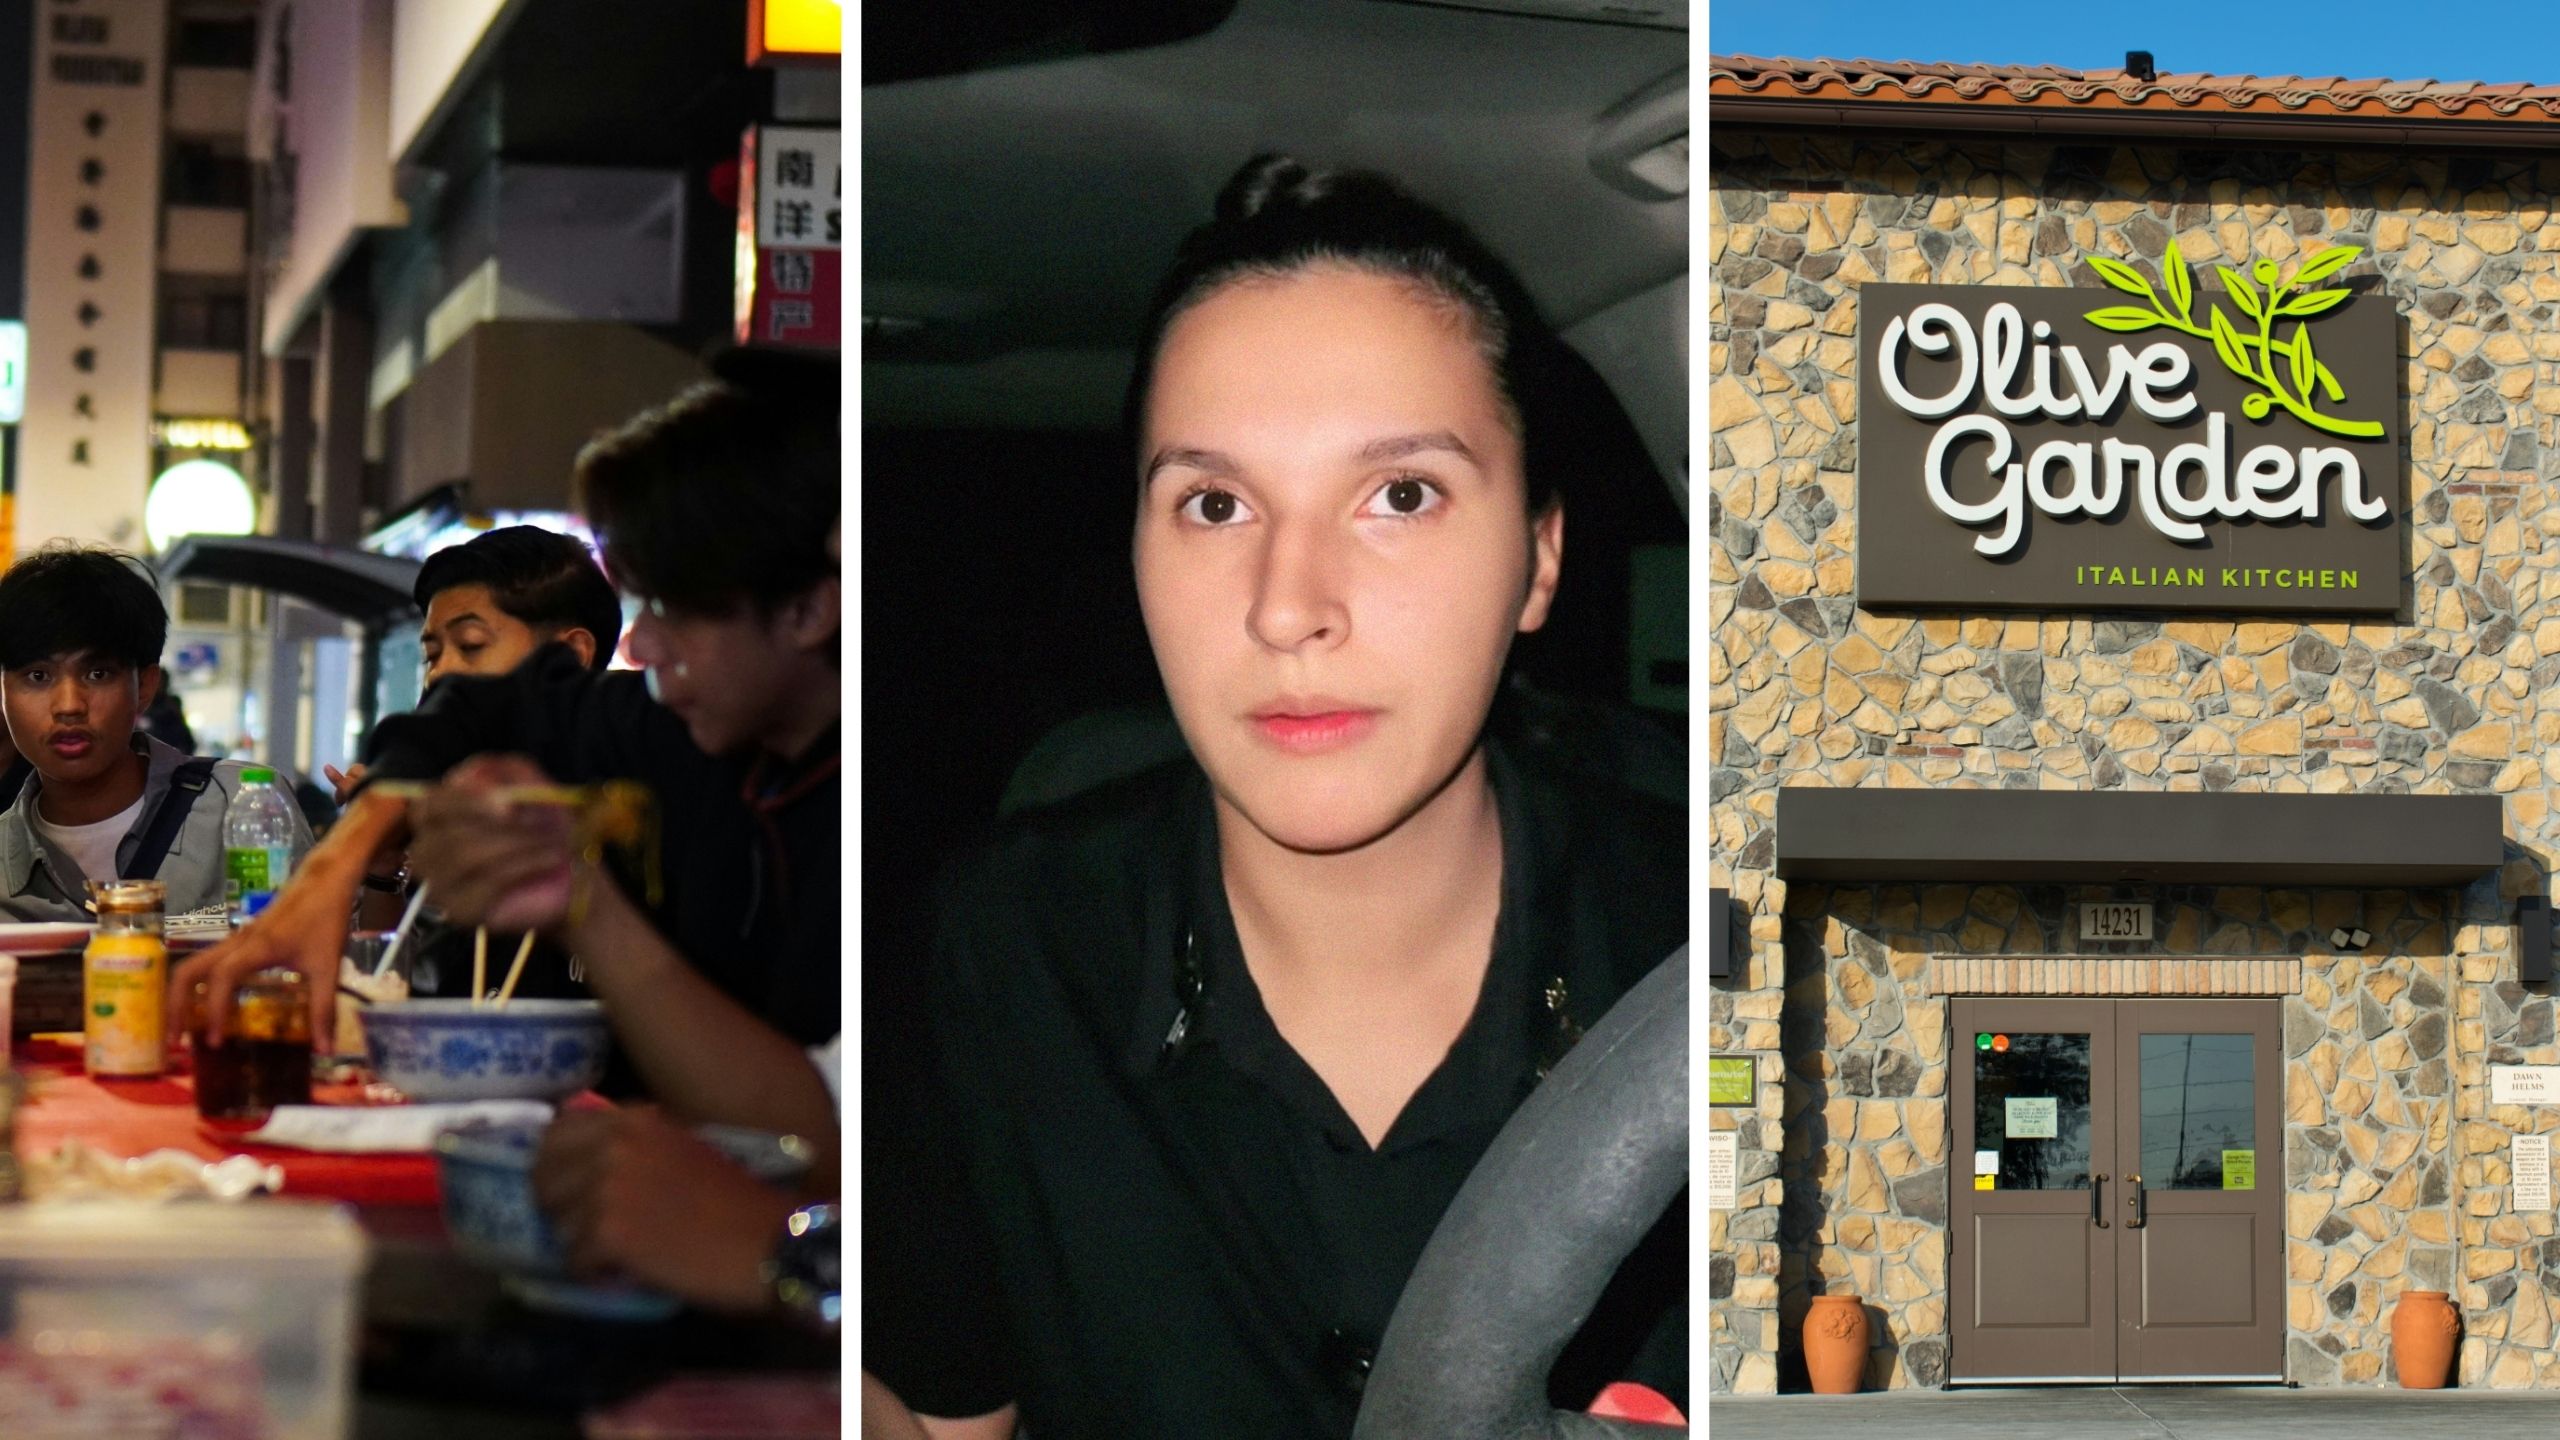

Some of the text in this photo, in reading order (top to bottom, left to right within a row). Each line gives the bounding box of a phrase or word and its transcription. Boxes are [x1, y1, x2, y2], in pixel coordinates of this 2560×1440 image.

[1878, 302, 2198, 423] Olive
[1924, 411, 2388, 558] Garden
[2076, 566, 2359, 589] ITALIAN KITCHEN
[2090, 906, 2143, 937] 14231
[2511, 1082, 2545, 1091] HELMS
[2513, 1072, 2542, 1081] DAWN
